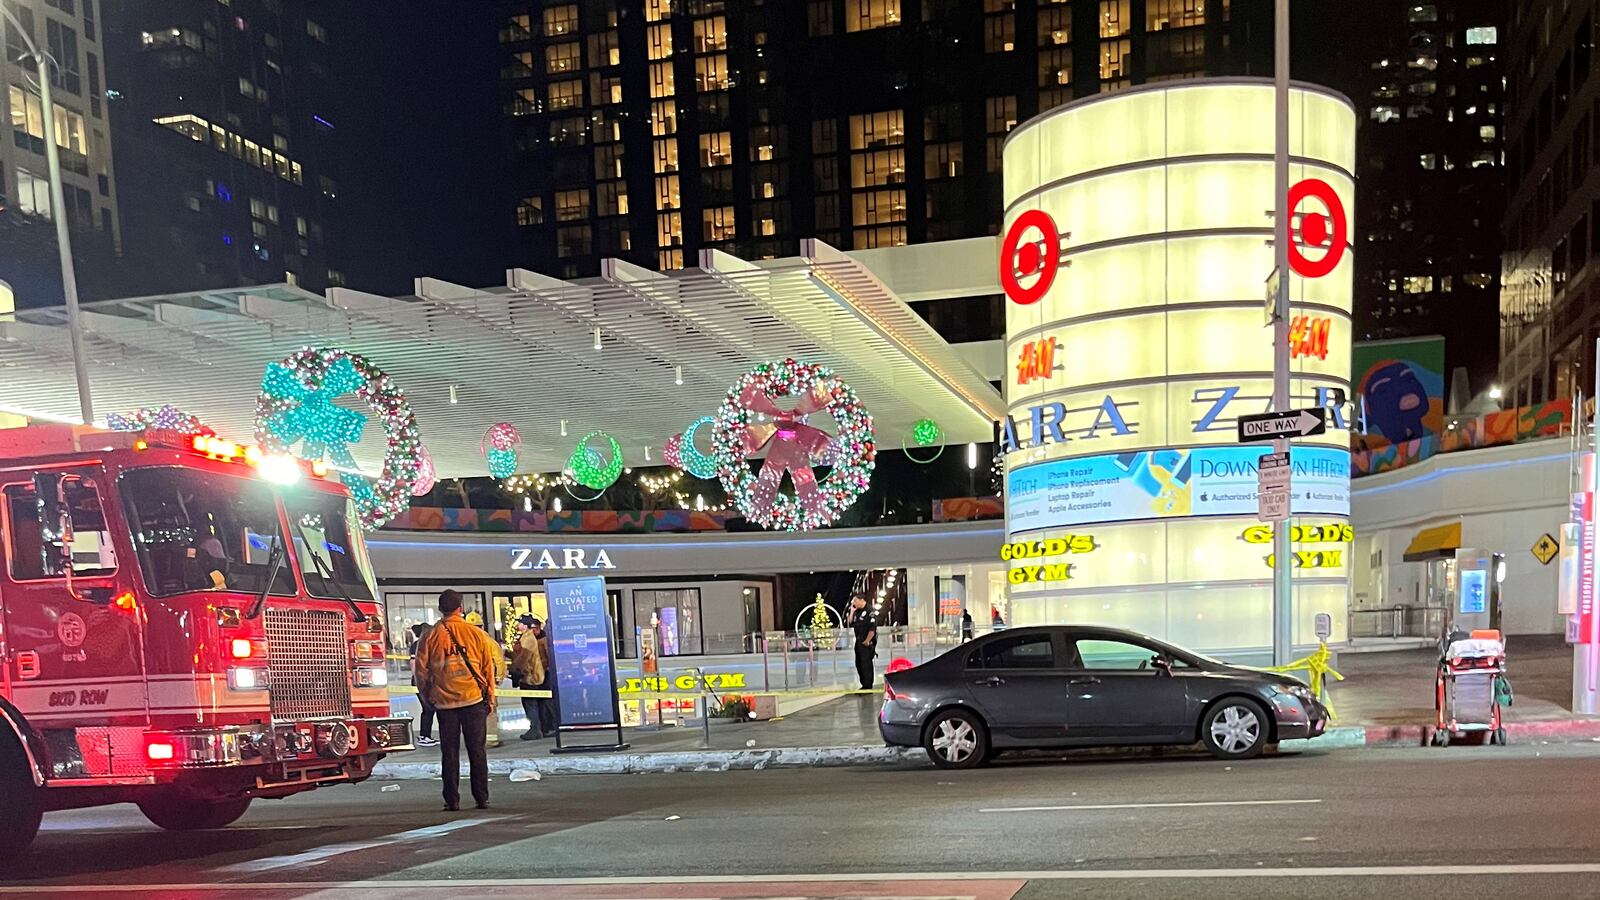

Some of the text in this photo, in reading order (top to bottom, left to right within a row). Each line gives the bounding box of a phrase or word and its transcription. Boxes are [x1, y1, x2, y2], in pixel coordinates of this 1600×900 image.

[1247, 419, 1298, 434] ONE WAY
[1070, 468, 1093, 478] Repair
[1048, 490, 1094, 502] Laptop Repair
[1212, 492, 1250, 501] Authorized
[1048, 500, 1112, 514] Apple Accessories
[1001, 534, 1094, 560] GOLD'S
[511, 548, 616, 570] ZARA
[1267, 550, 1342, 568] YM
[1008, 563, 1068, 584] GYM
[570, 588, 582, 596] AN
[555, 595, 598, 605] ELEVATED
[568, 604, 586, 612] LIFE
[676, 673, 746, 689] GYM
[80, 690, 108, 705] ROW
[348, 725, 358, 750] 9
